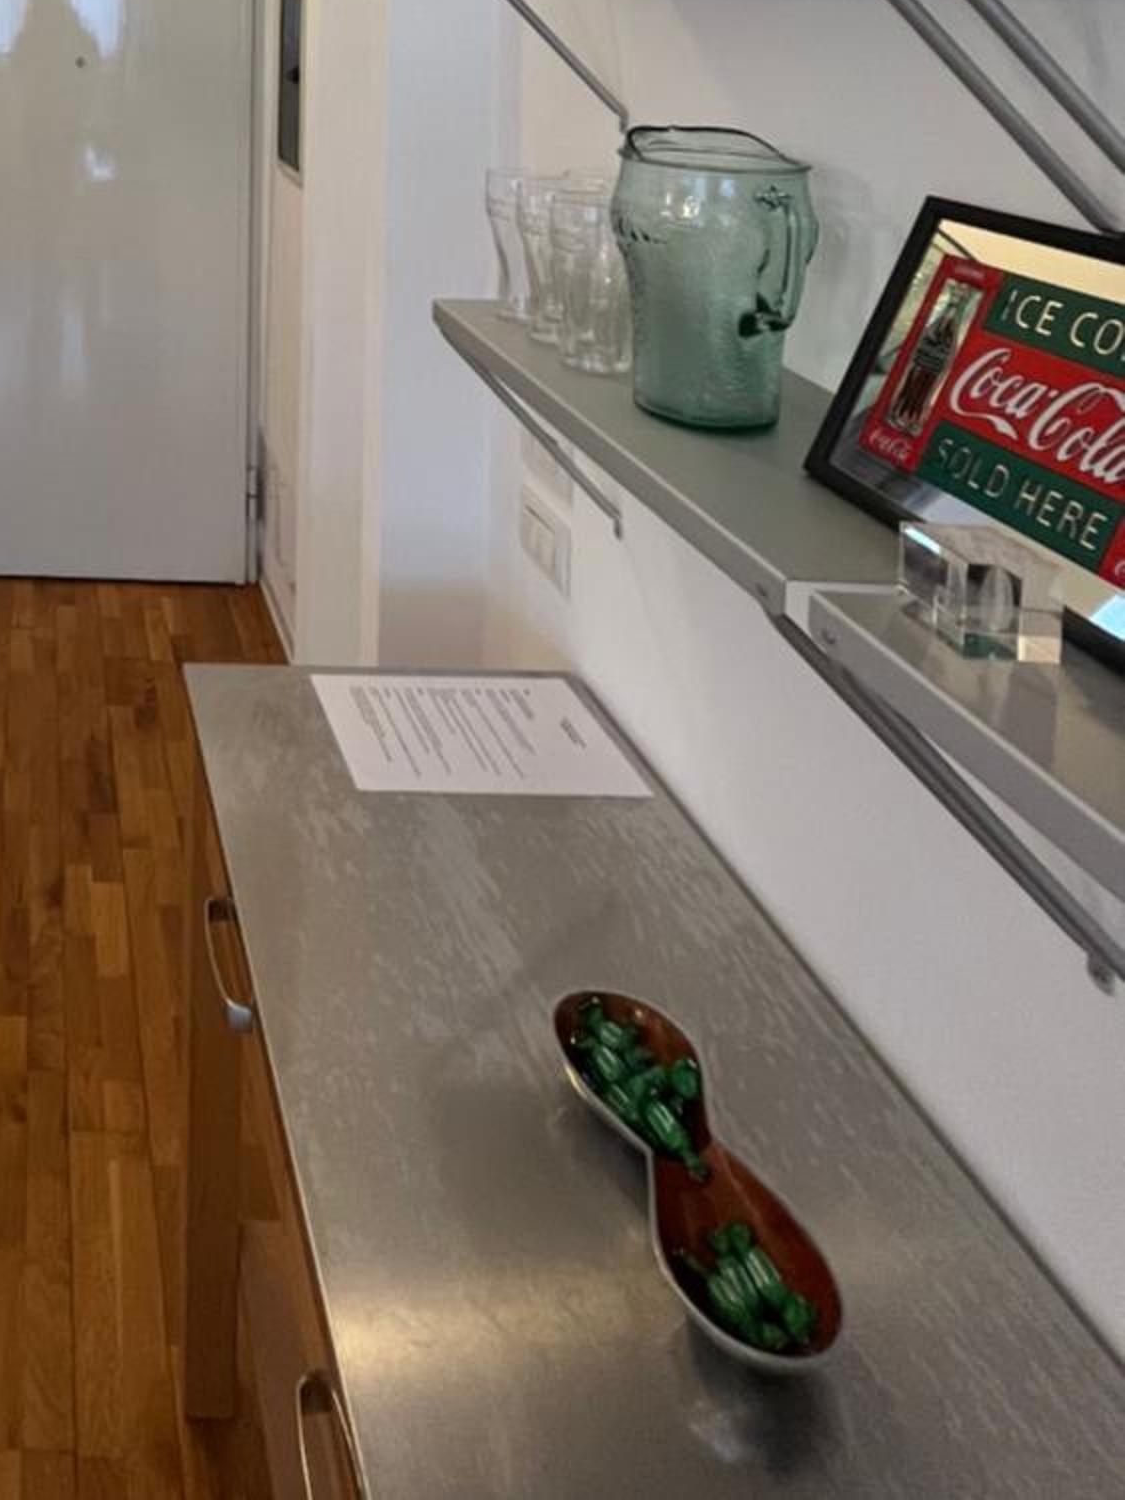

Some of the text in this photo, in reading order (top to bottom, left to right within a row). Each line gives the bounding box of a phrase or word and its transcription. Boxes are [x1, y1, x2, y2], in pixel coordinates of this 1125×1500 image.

[1001, 289, 1125, 362] ICE CO
[938, 438, 1011, 498] SOLD
[1013, 477, 1109, 551] HERE
